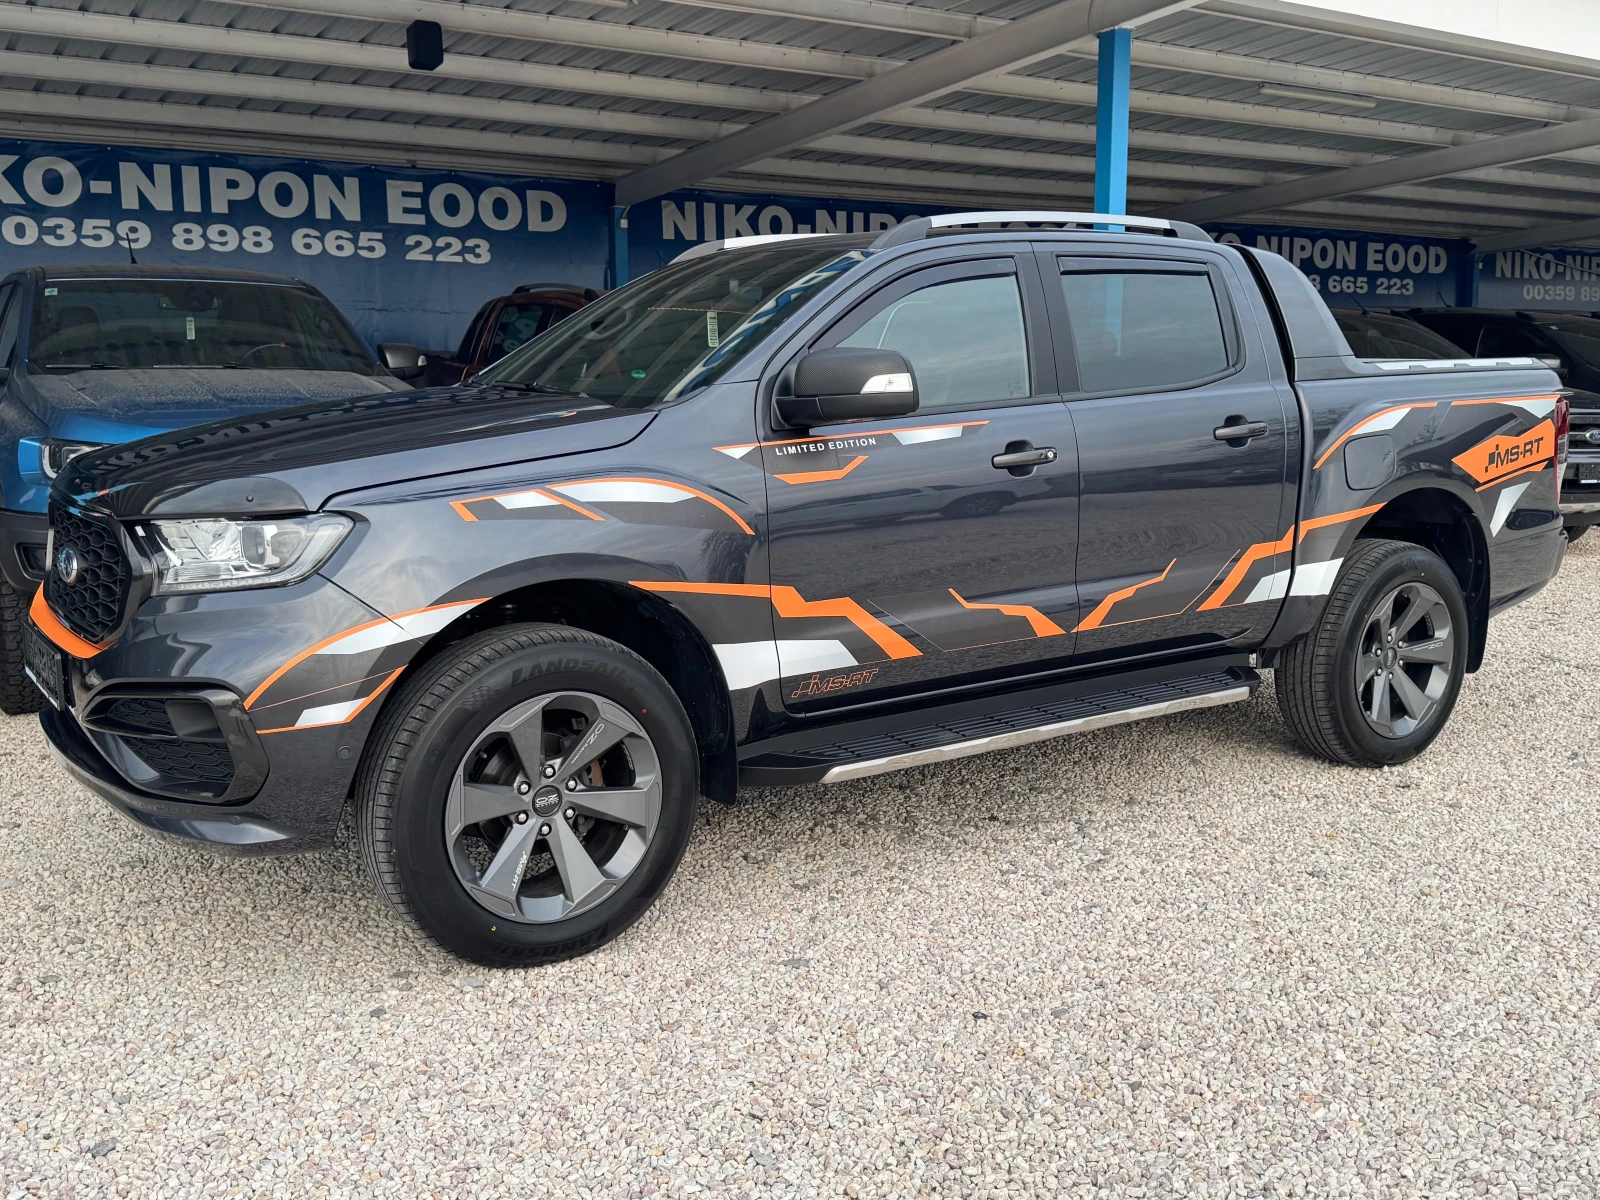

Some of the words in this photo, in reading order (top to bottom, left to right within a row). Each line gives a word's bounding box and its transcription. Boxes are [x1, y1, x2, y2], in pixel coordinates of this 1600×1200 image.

[387, 180, 567, 232] EOOD
[171, 222, 274, 254] 898
[291, 228, 386, 259] 665
[404, 234, 492, 265] 223
[1366, 242, 1448, 275] EOOD
[1328, 275, 1368, 294] 665
[1375, 277, 1414, 296] 223
[1523, 284, 1576, 301] 00359
[775, 442, 825, 456] LIMITED
[829, 437, 876, 450] EDITION
[511, 658, 629, 689] LANDSAIL
